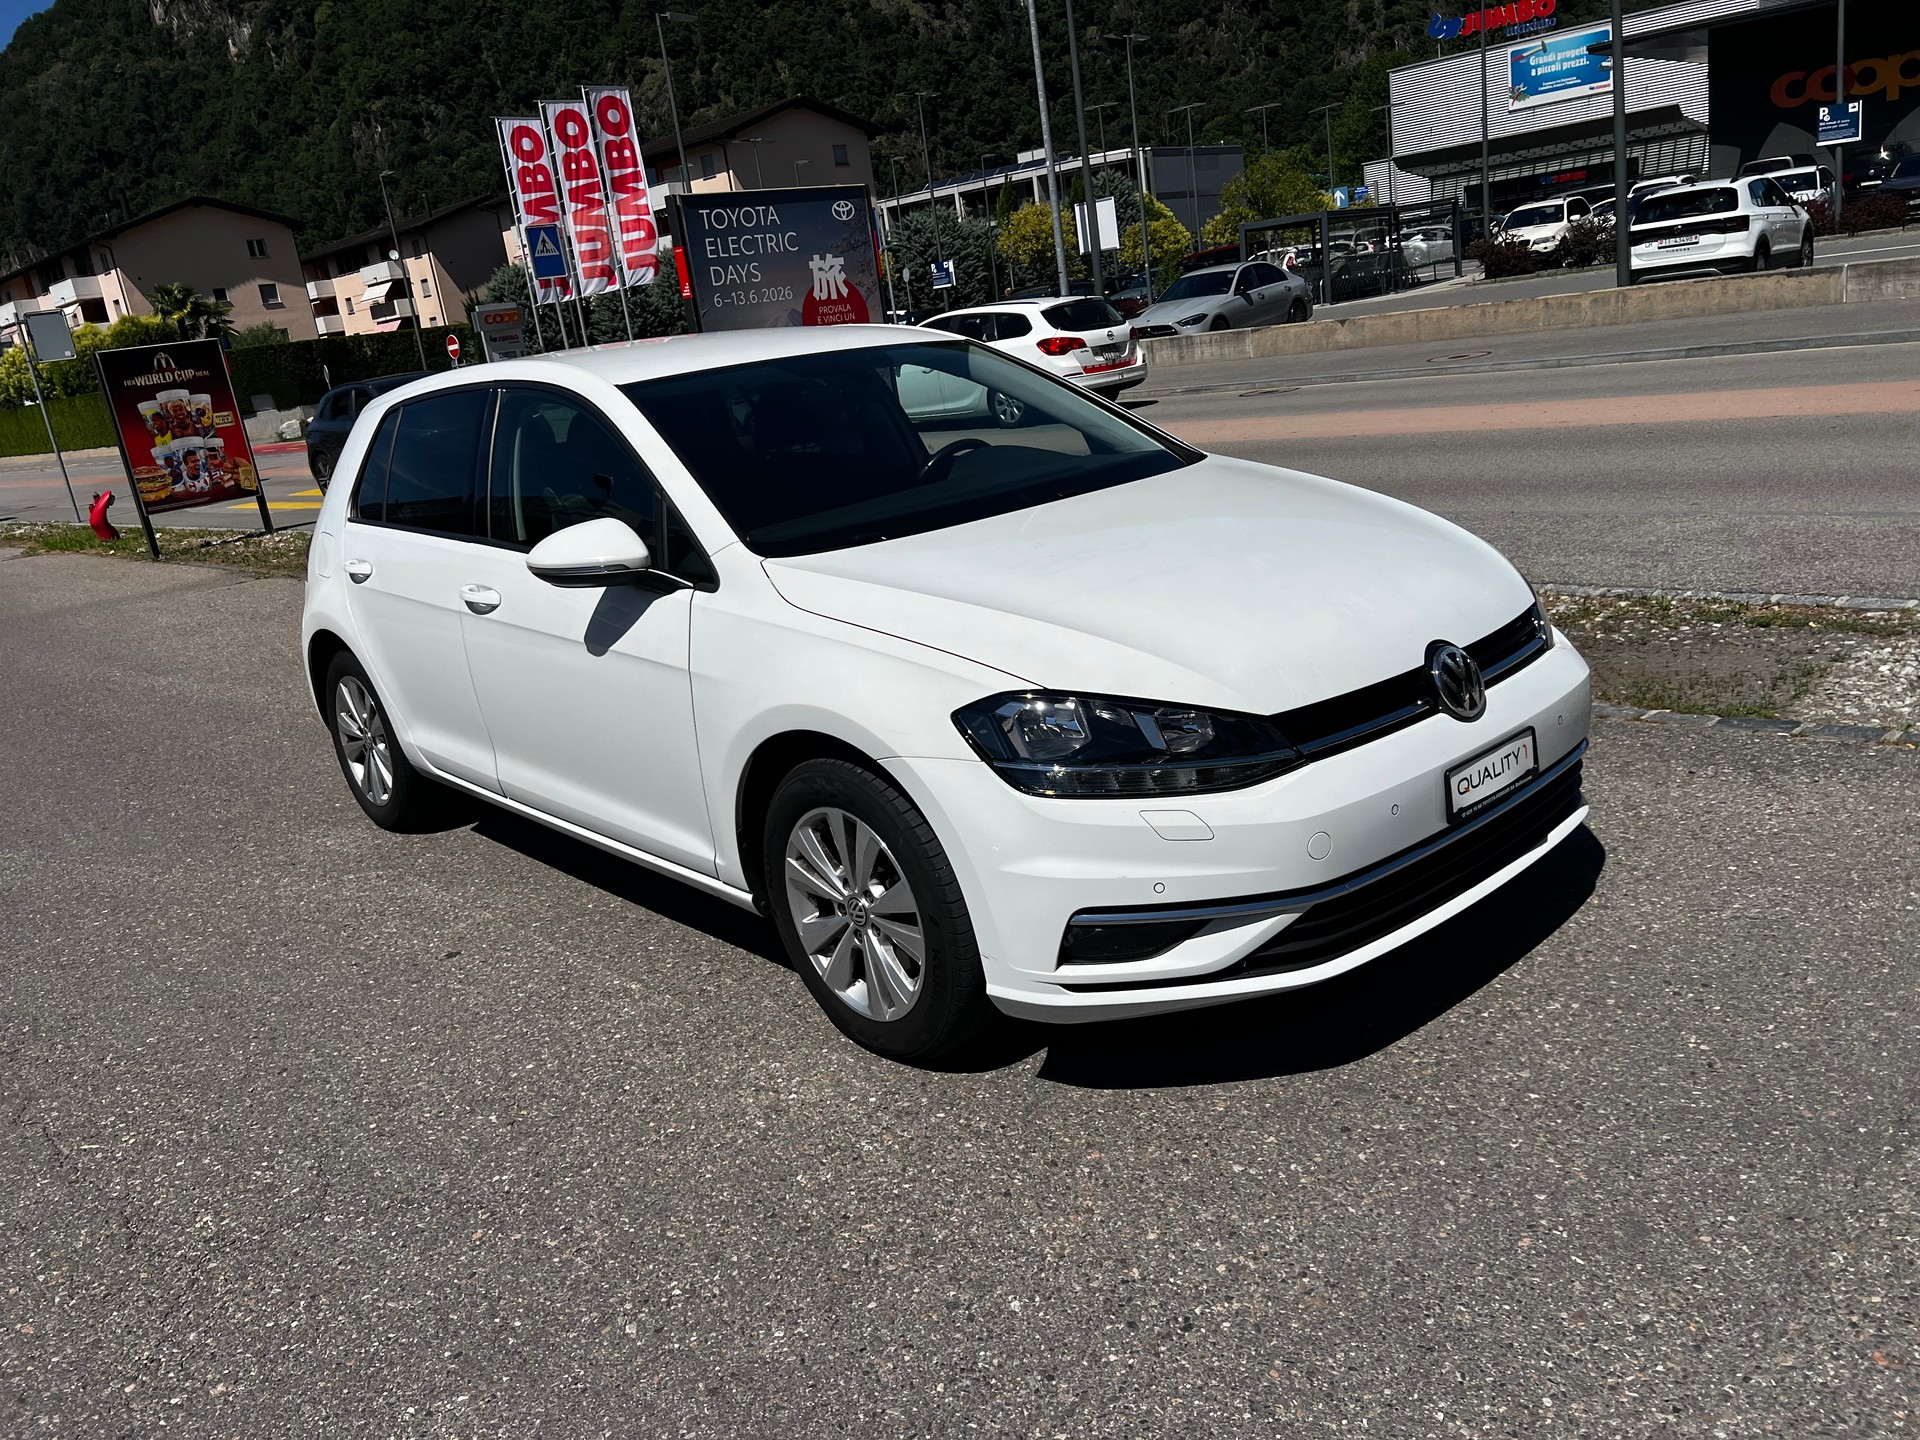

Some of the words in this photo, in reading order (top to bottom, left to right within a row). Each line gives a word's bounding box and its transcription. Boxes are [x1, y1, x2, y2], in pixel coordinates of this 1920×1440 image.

[1461, 0, 1556, 36] JUMBO
[1529, 50, 1556, 66] Grandi
[1537, 60, 1562, 76] piccoli
[1562, 56, 1590, 70] prezzi.
[554, 108, 618, 286] JUMBO
[596, 95, 660, 277] JUMBO
[698, 205, 781, 230] TOYOTA
[705, 231, 799, 259] ELECTRIC
[709, 262, 762, 286] DAYS
[808, 253, 849, 301] 旅
[817, 315, 822, 325] E
[822, 313, 843, 323] VINCI
[844, 311, 856, 321] UN
[818, 303, 852, 315] PROVALA
[134, 371, 173, 387] WORLD
[174, 369, 195, 383] CUP
